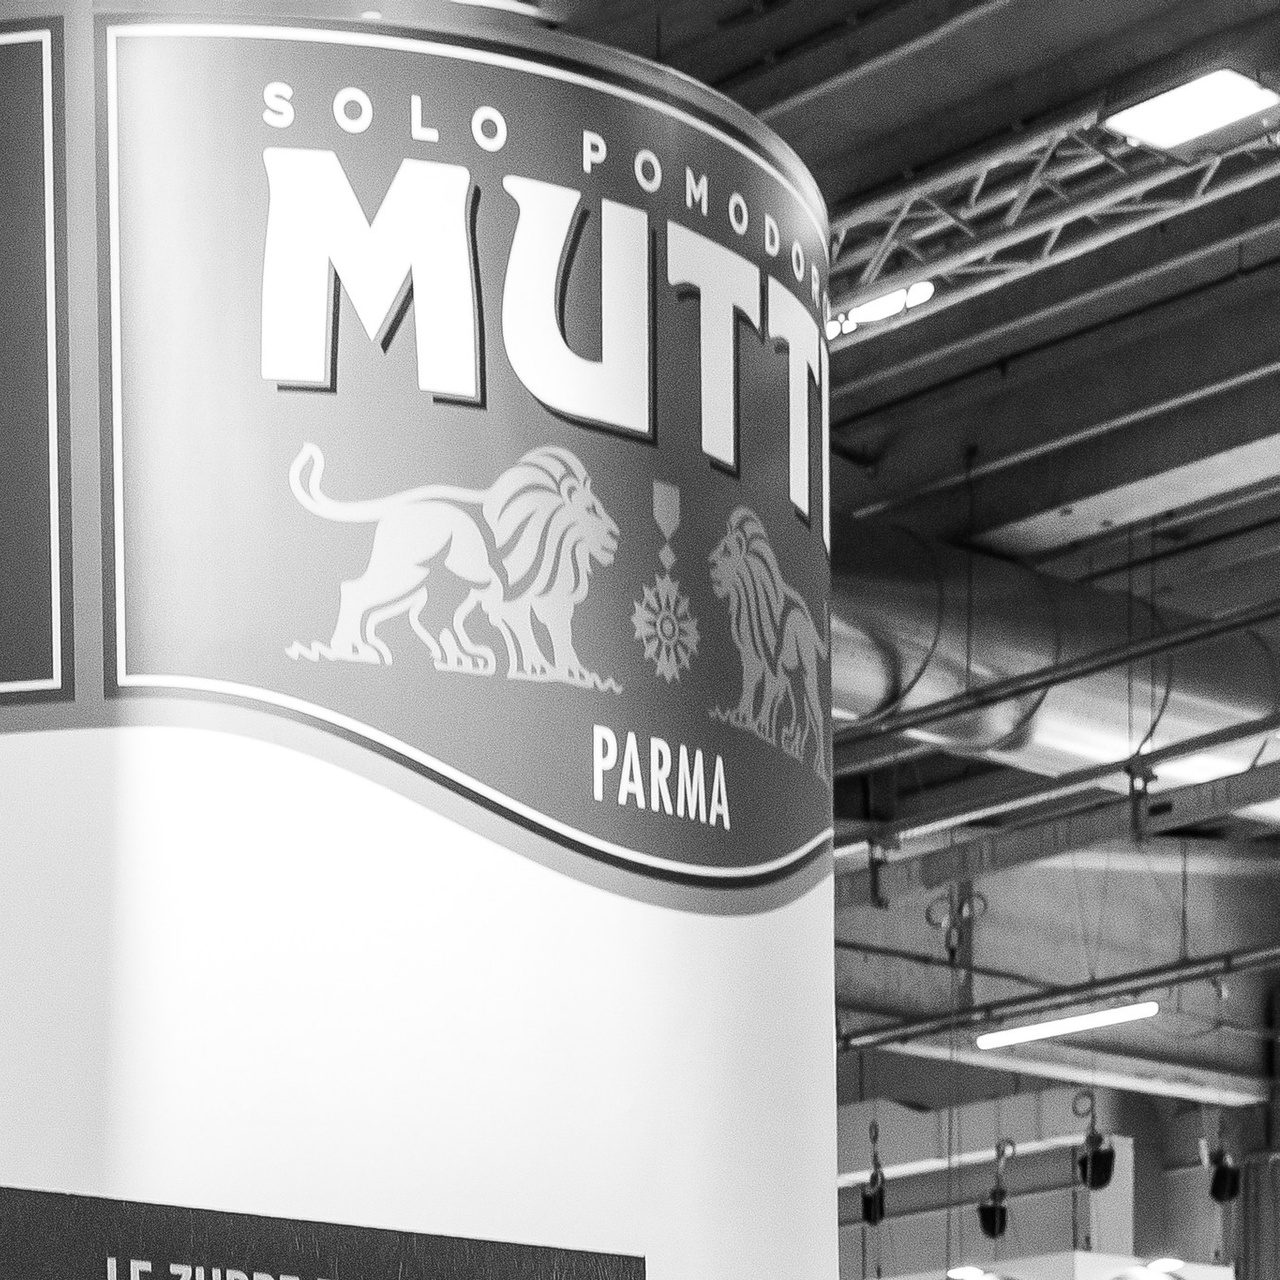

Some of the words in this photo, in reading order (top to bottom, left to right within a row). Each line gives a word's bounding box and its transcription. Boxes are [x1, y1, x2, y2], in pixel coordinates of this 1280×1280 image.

[261, 82, 508, 152] SOLO
[260, 146, 830, 555] MUTT
[592, 724, 731, 831] PARMA
